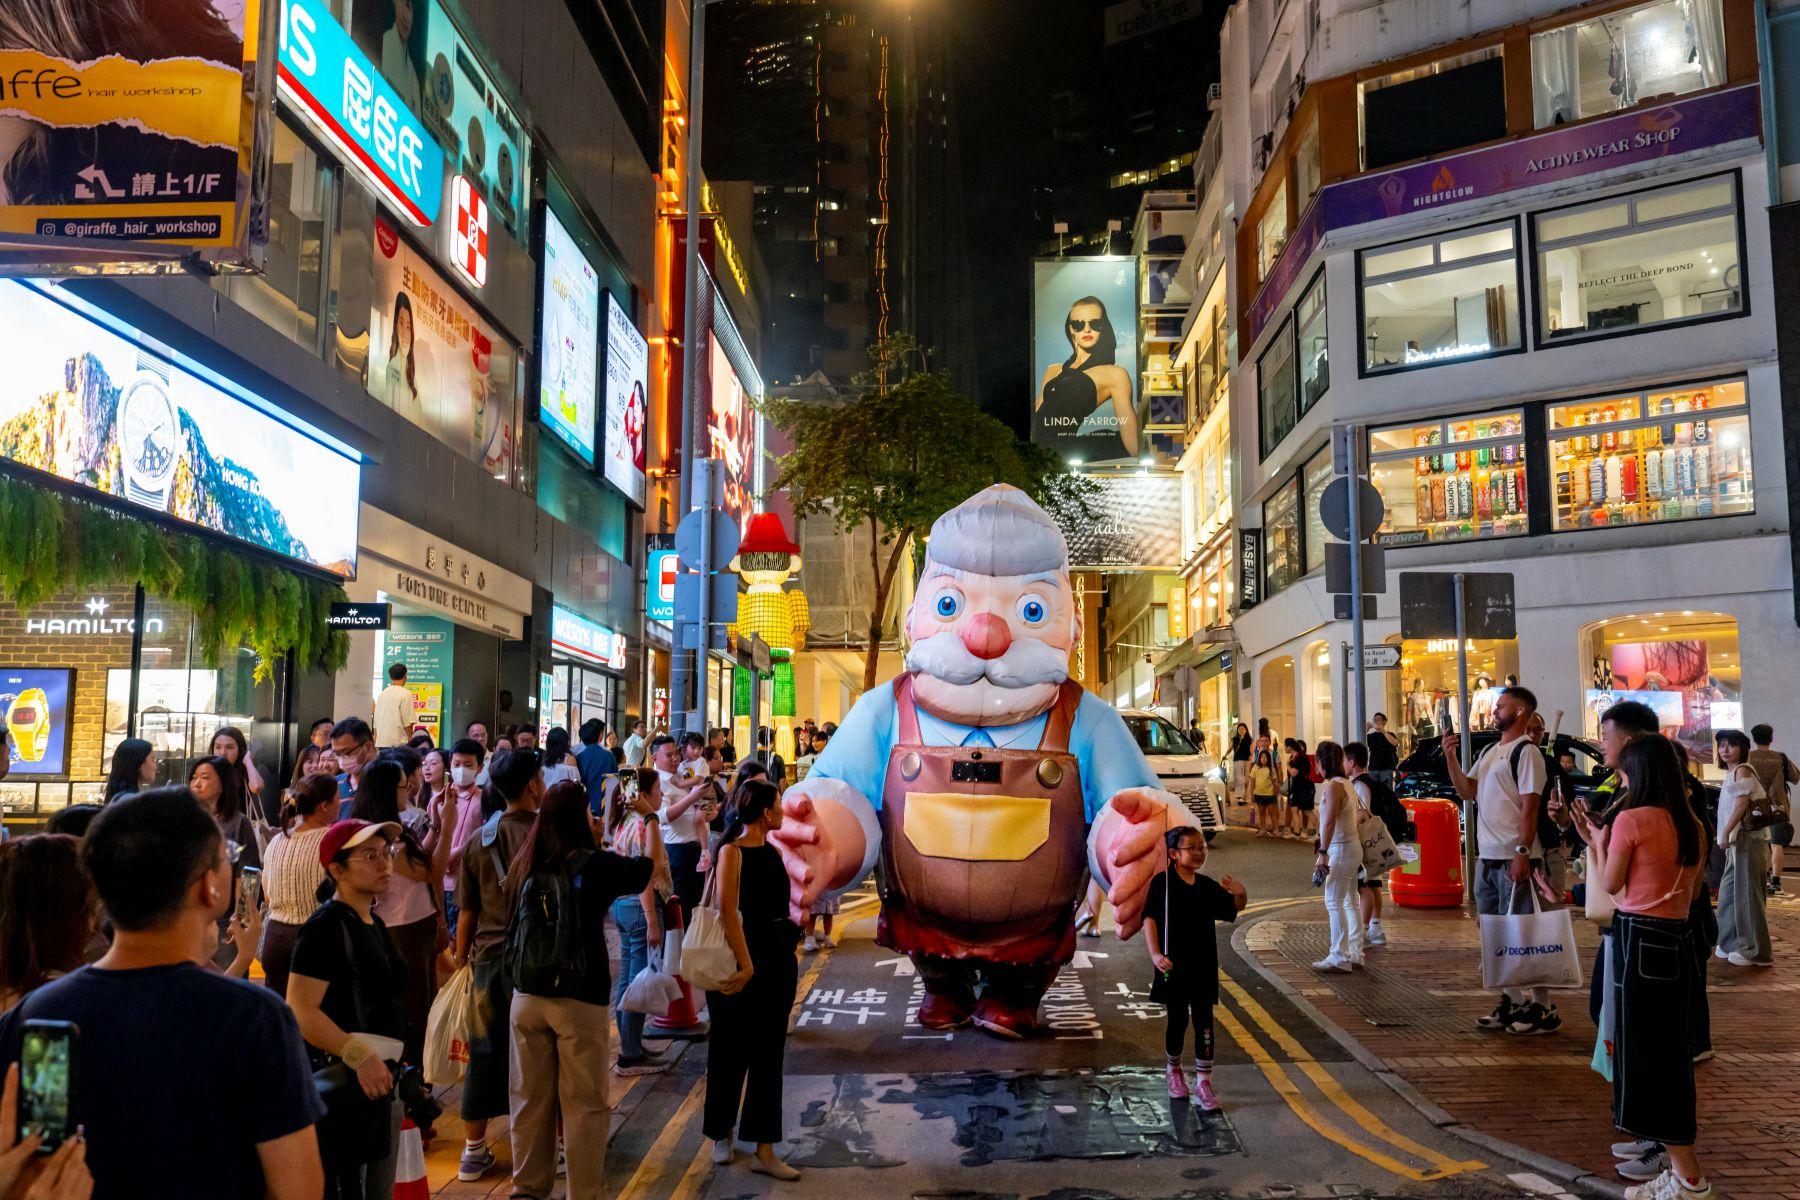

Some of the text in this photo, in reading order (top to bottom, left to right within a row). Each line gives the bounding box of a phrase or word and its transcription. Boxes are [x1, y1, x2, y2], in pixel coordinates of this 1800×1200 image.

[87, 87, 117, 97] hair
[123, 86, 202, 98] workshop
[343, 56, 423, 198] 屈臣氏
[1525, 126, 1681, 175] ACTIVEWEAR SHOP
[1413, 185, 1475, 207] NIGHTGLOW
[64, 221, 217, 238] @giraffe_hair_workshop
[1578, 276, 1617, 289] REFLECT
[1620, 274, 1639, 282] THE
[1640, 268, 1665, 278] DEEP
[1666, 262, 1694, 273] BOND
[1044, 416, 1129, 427] LINDA FARROW
[221, 466, 249, 491] HONG
[1446, 480, 1456, 516] Supreme
[1244, 534, 1254, 602] BASEMENT
[397, 572, 488, 622] FORTUNE CENTRE
[325, 615, 381, 625] HAMILTON
[387, 645, 402, 656] 2F
[1427, 638, 1476, 653] INITIL
[1508, 943, 1563, 957] DECATHLON
[1043, 1003, 1104, 1040] LOOK
